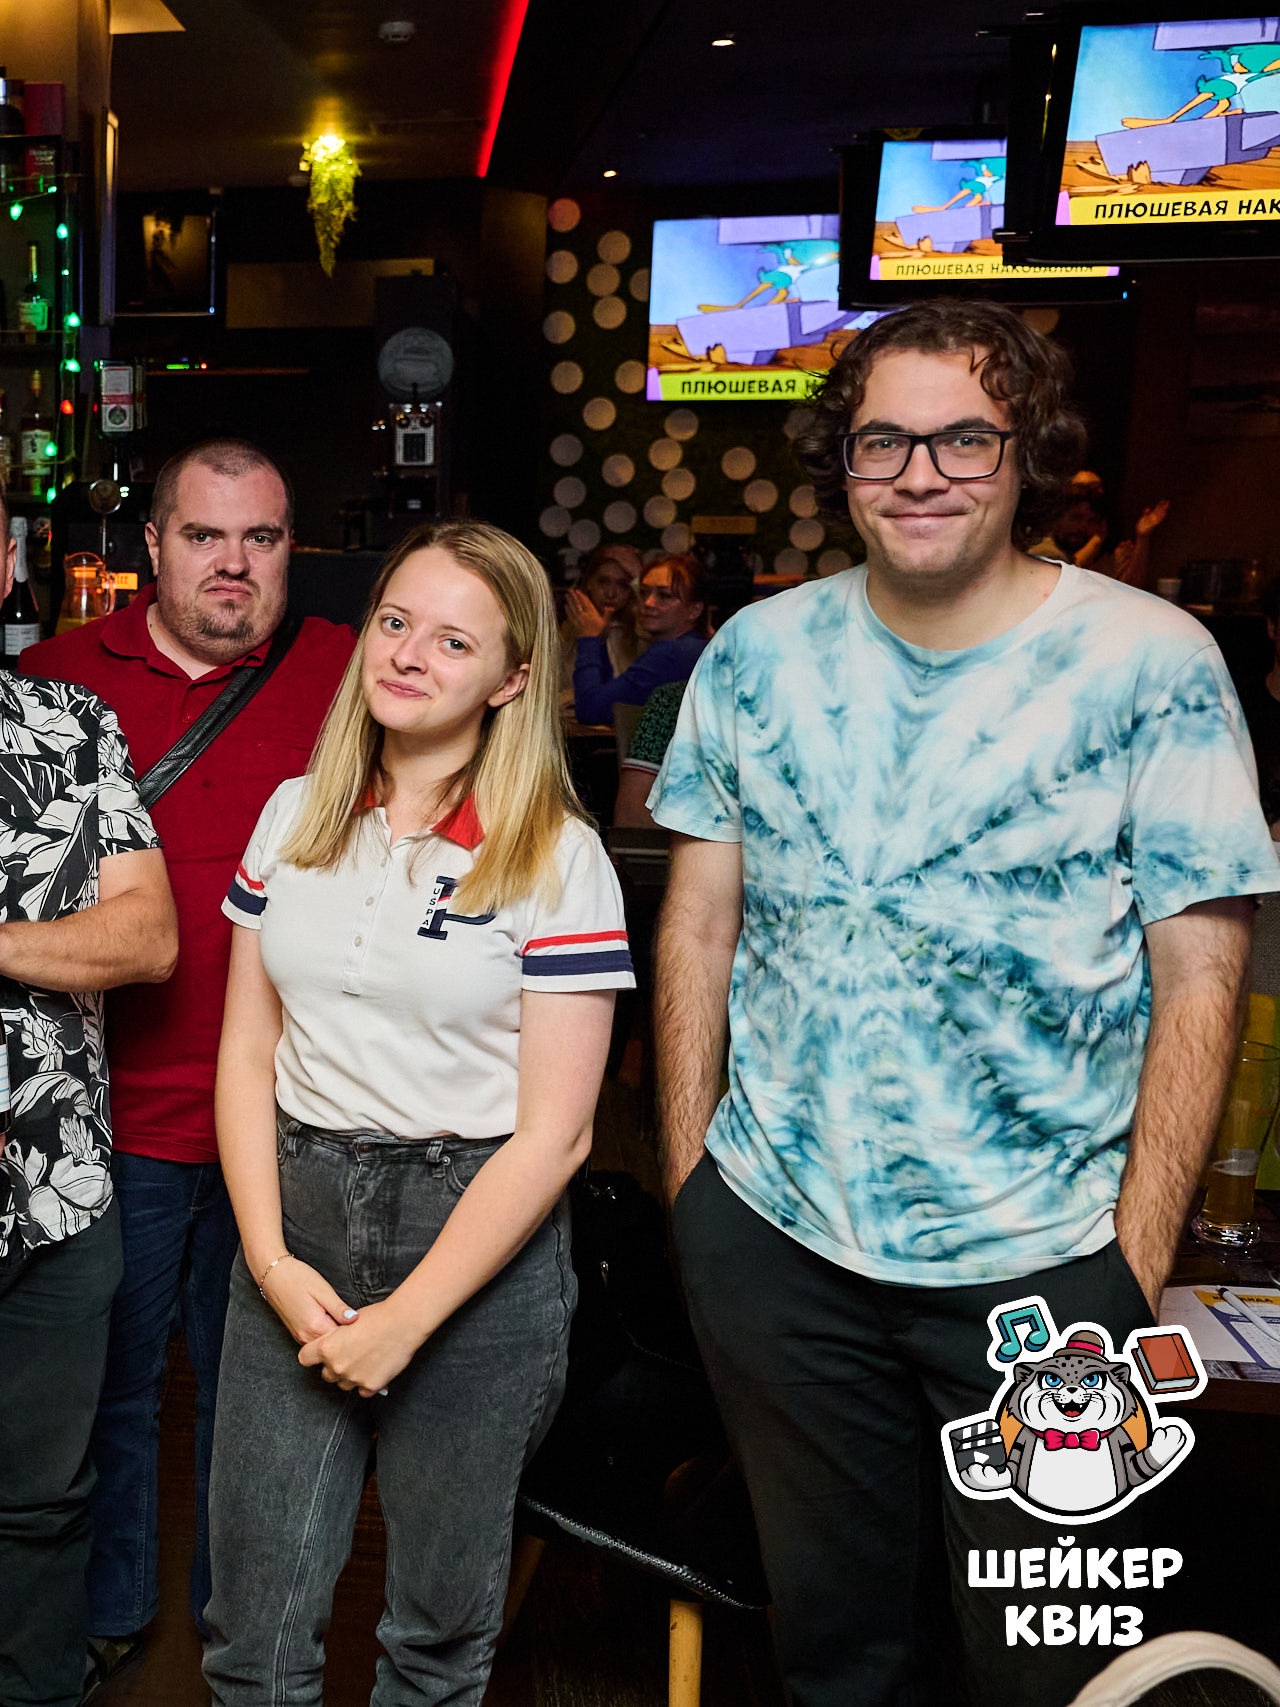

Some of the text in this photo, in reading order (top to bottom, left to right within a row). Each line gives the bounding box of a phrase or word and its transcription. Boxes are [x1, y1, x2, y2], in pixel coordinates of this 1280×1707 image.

[1095, 200, 1228, 219] ПЛЮШЕВАЯ
[896, 263, 985, 276] ПЛЮШЕВАЯ
[681, 379, 796, 394] ПЛЮШЕВАЯ
